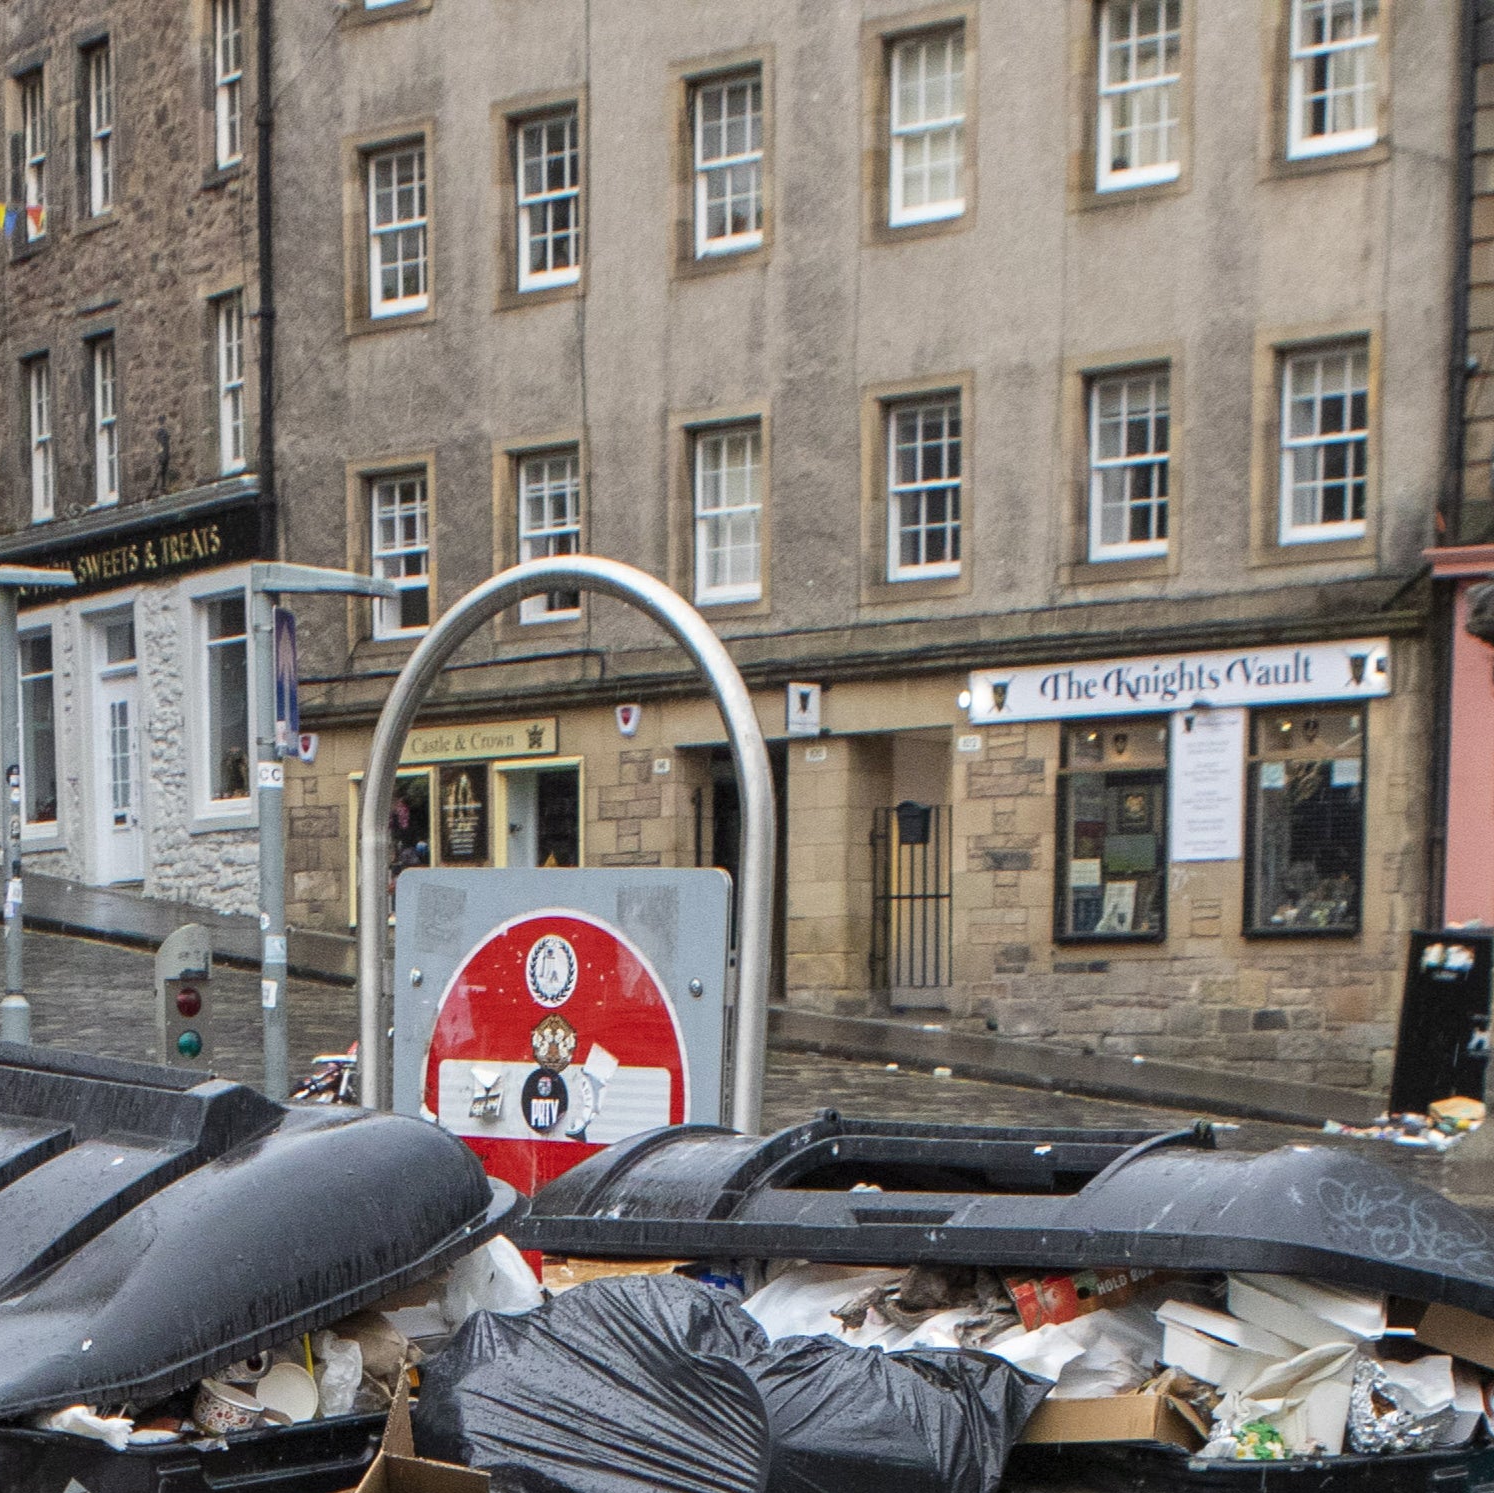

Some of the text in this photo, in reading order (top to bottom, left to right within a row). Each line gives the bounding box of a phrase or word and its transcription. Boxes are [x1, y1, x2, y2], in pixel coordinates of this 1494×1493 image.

[77, 543, 140, 585] SWEETS
[145, 539, 159, 570] &
[163, 524, 222, 562] TREATS
[1041, 652, 1314, 702] The Knights Vault
[411, 731, 514, 755] Castle & Crown
[1096, 1274, 1129, 1296] HOLD
